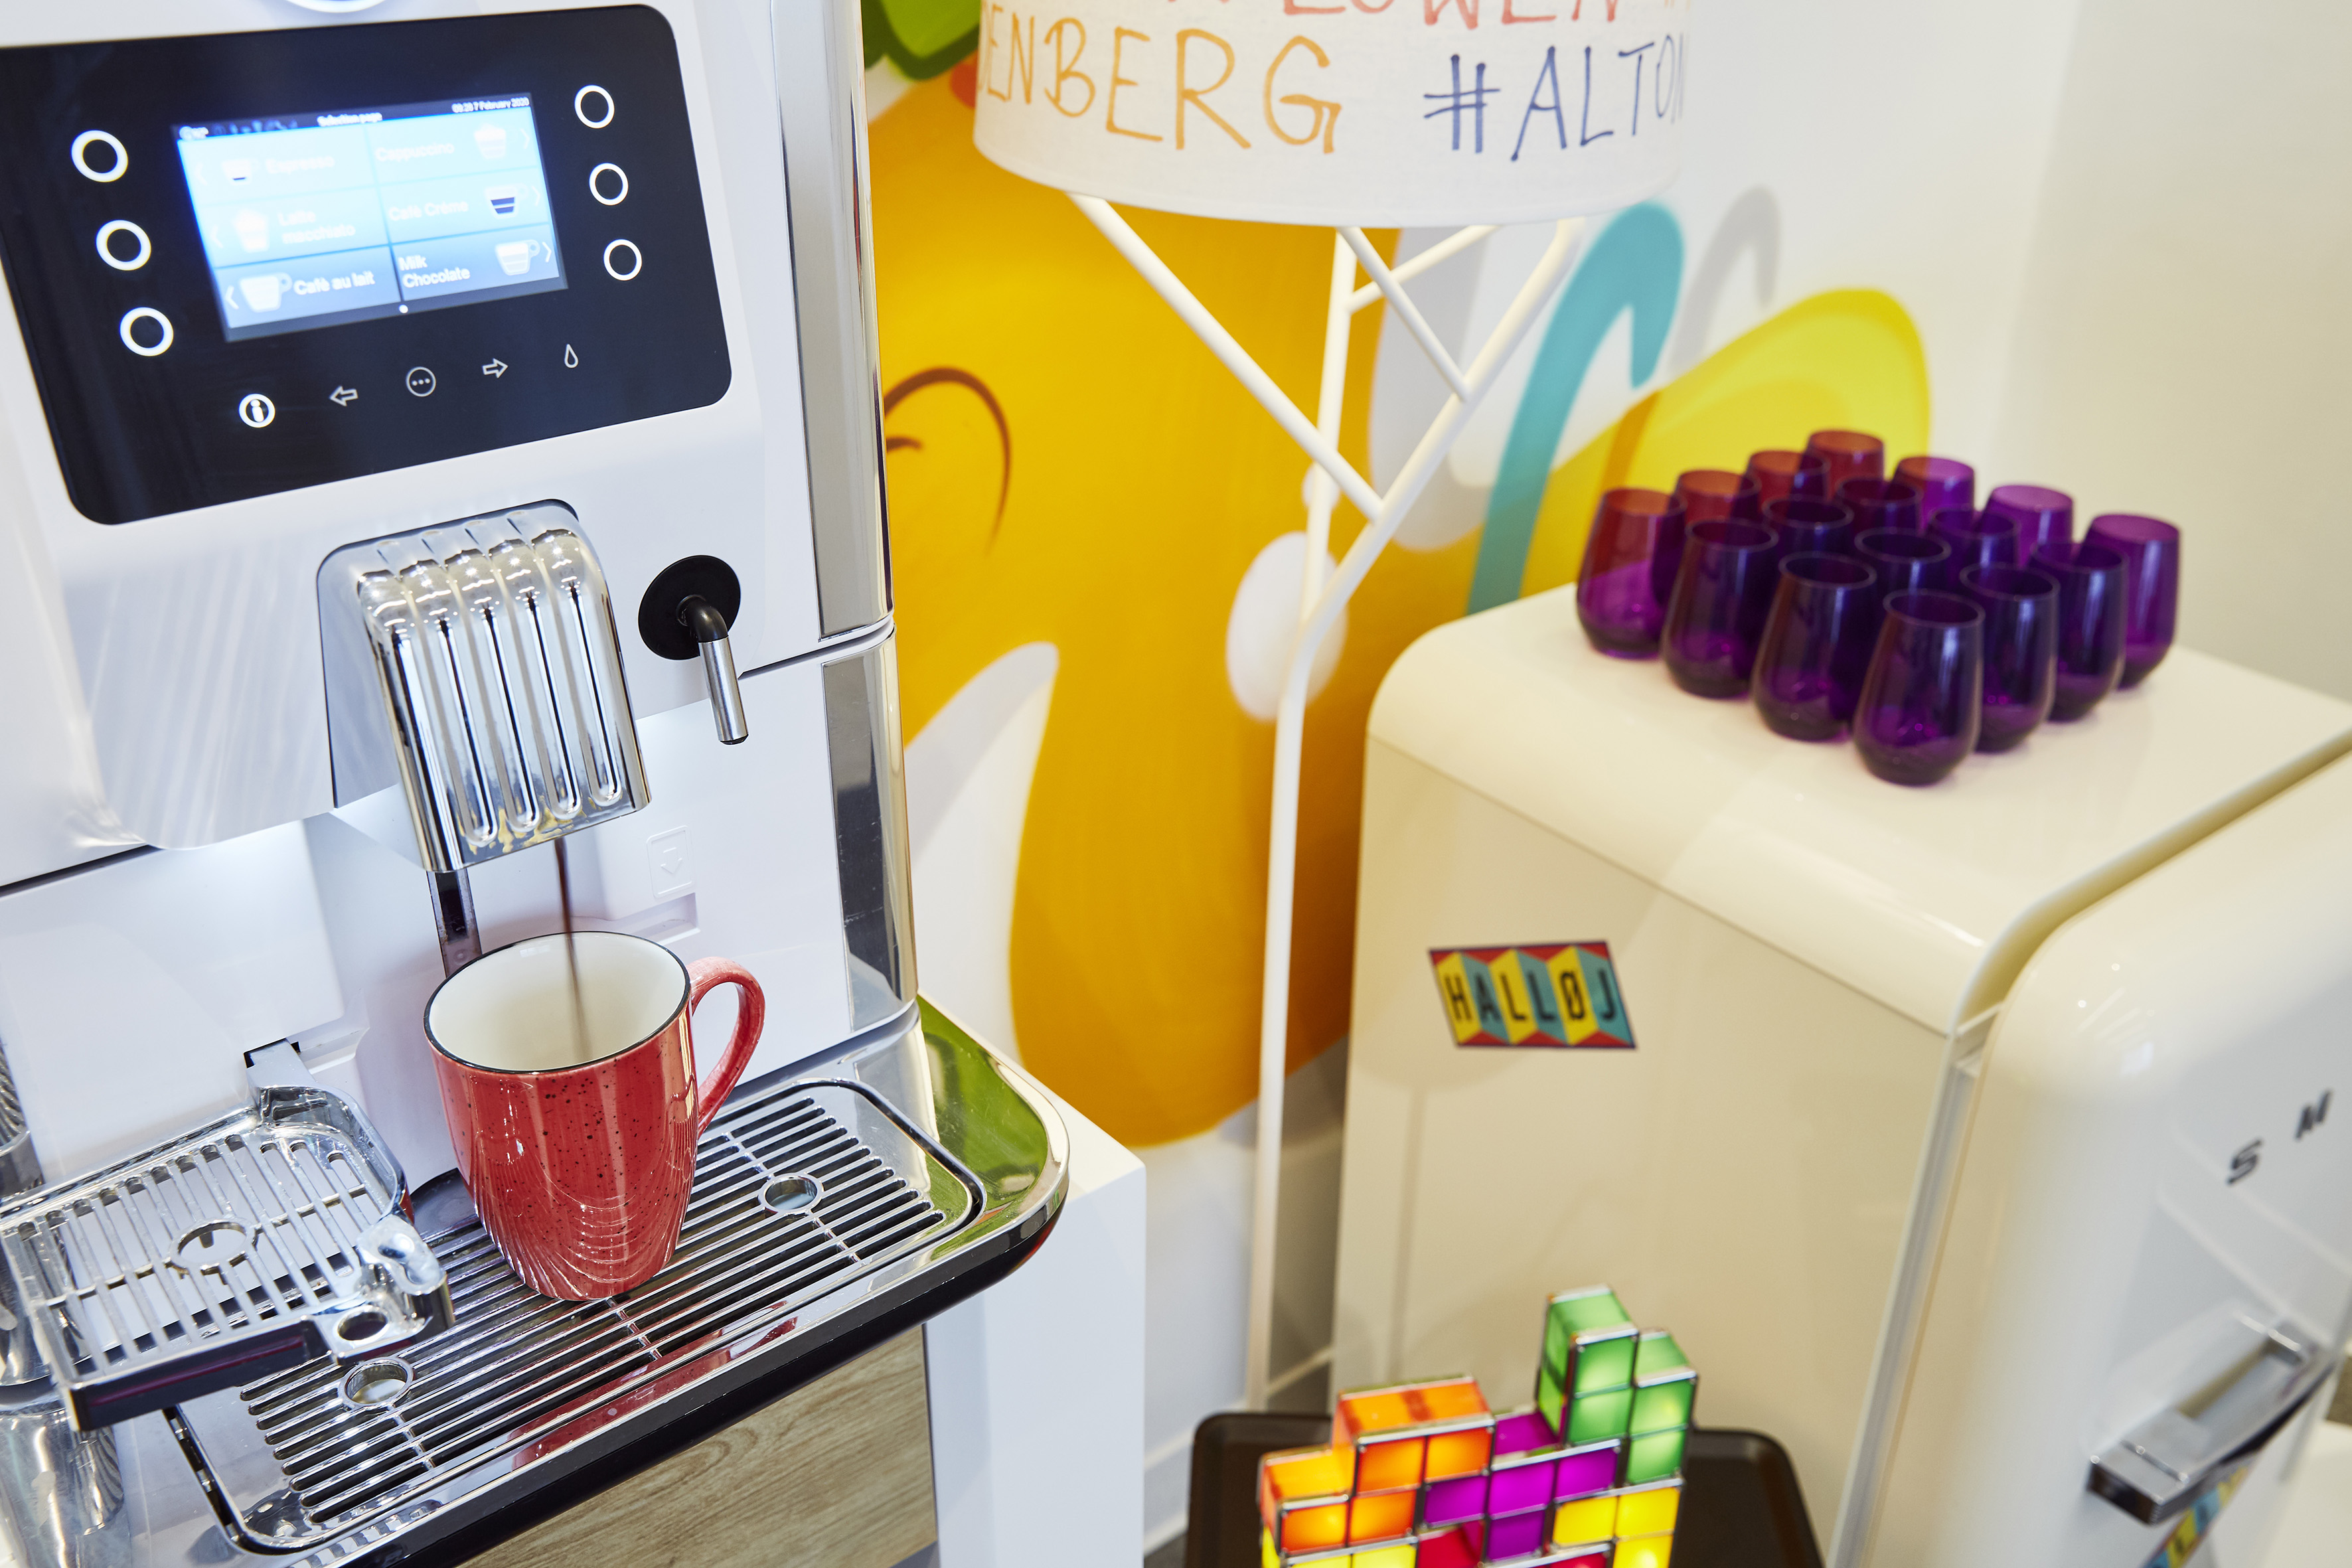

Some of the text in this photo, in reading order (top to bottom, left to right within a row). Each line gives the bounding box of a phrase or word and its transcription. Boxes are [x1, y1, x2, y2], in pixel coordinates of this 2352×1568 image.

[479, 101, 511, 110] February
[511, 98, 530, 108] 2020
[374, 141, 455, 163] Cappuccino
[266, 155, 335, 175] Espresso
[277, 210, 316, 226] Latte
[281, 223, 356, 244] macchiato
[398, 254, 428, 271] Milk
[331, 275, 352, 290] au
[351, 270, 376, 287] lait
[402, 267, 471, 288] Chocolate
[1443, 968, 1616, 1022] HALLØJ
